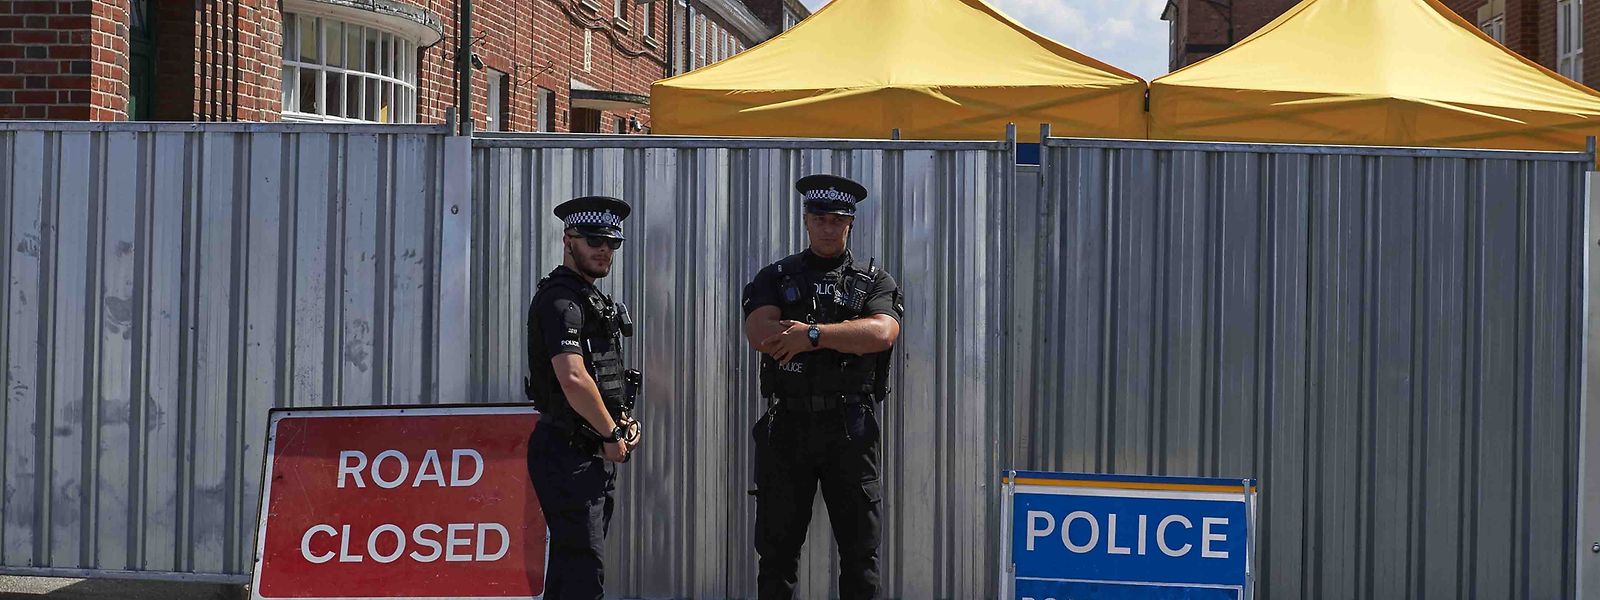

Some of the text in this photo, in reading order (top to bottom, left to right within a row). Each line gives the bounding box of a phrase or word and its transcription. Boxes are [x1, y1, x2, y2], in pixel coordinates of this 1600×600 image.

[814, 283, 835, 295] OLIC
[561, 339, 580, 348] POLICE
[337, 448, 484, 489] ROAD
[301, 522, 510, 564] CLOSED
[1026, 510, 1229, 559] POLICE
